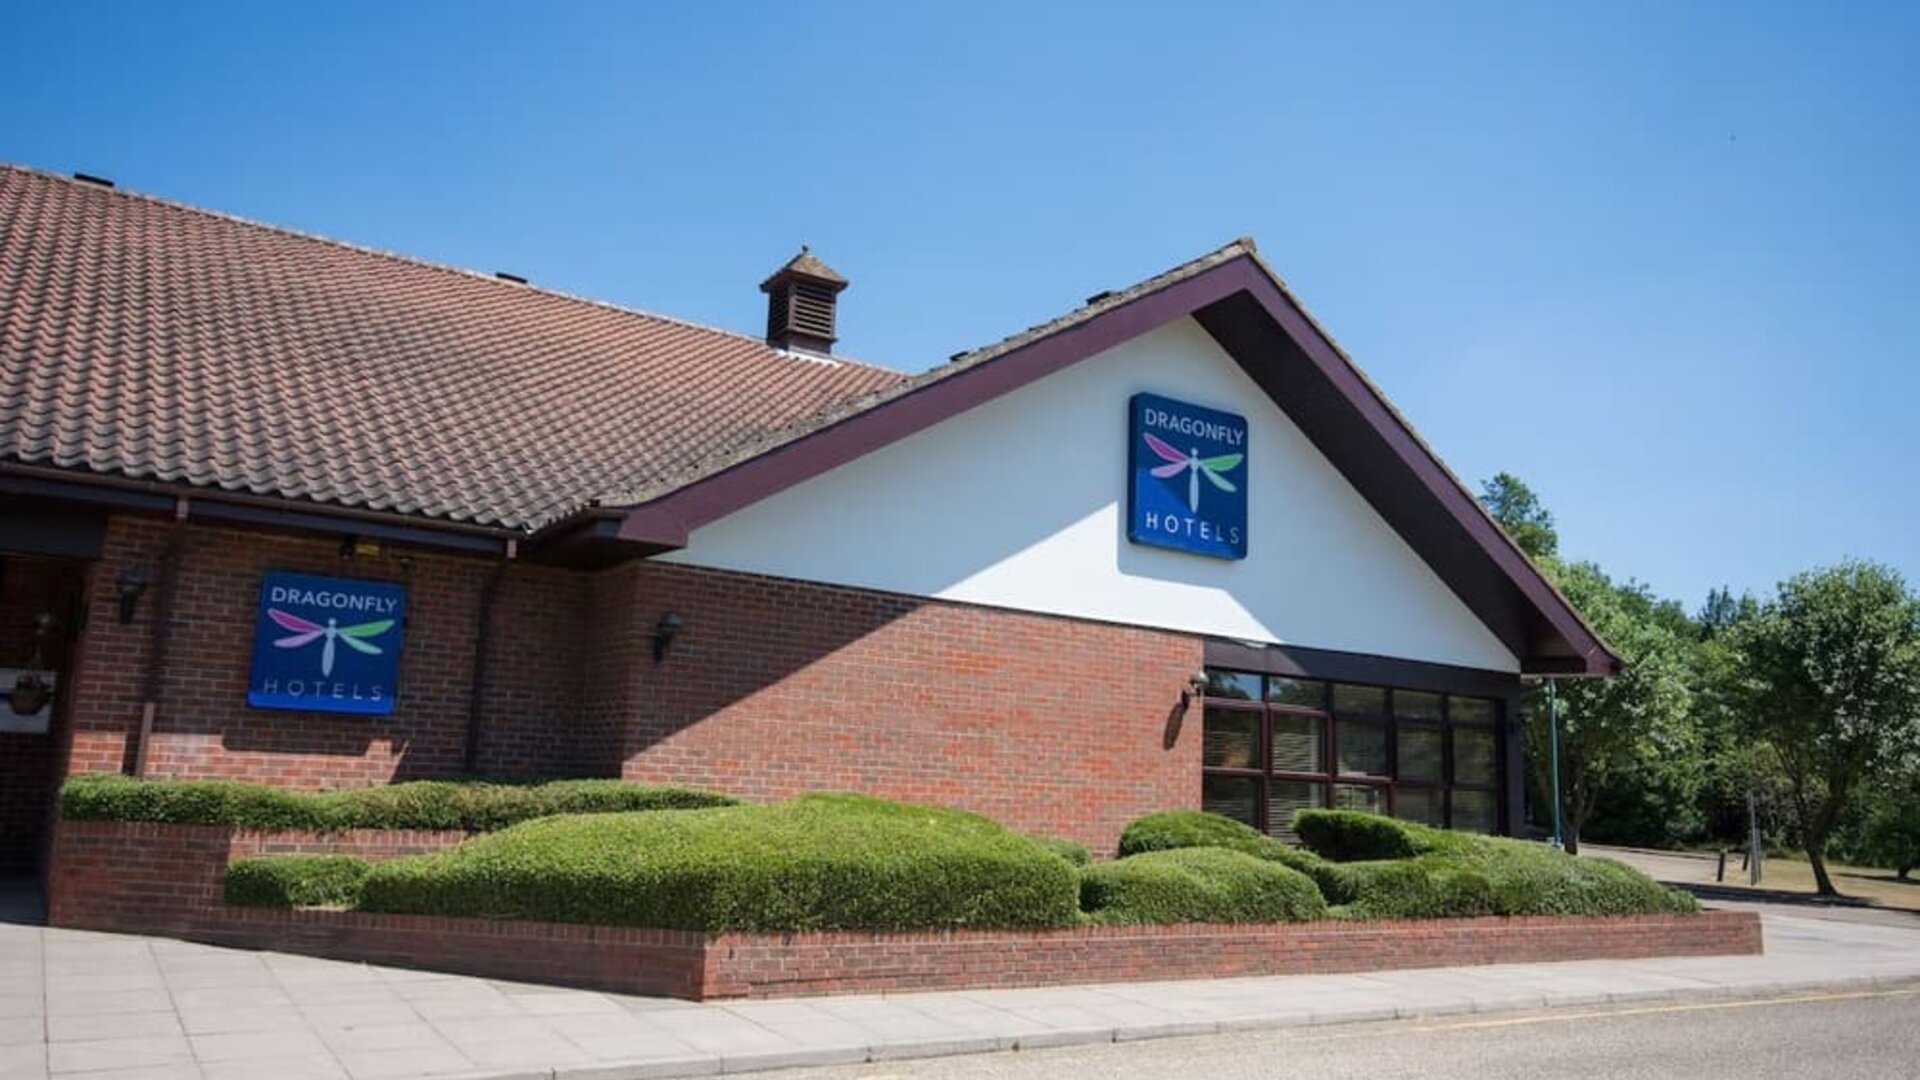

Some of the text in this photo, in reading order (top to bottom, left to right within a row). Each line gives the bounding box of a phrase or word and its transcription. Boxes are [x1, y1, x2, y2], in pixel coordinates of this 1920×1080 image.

[1144, 408, 1244, 446] DRAGONFLY
[1145, 511, 1240, 545] HOTELS
[271, 586, 397, 613] DRAGONFLY
[263, 678, 383, 701] HOTELS
